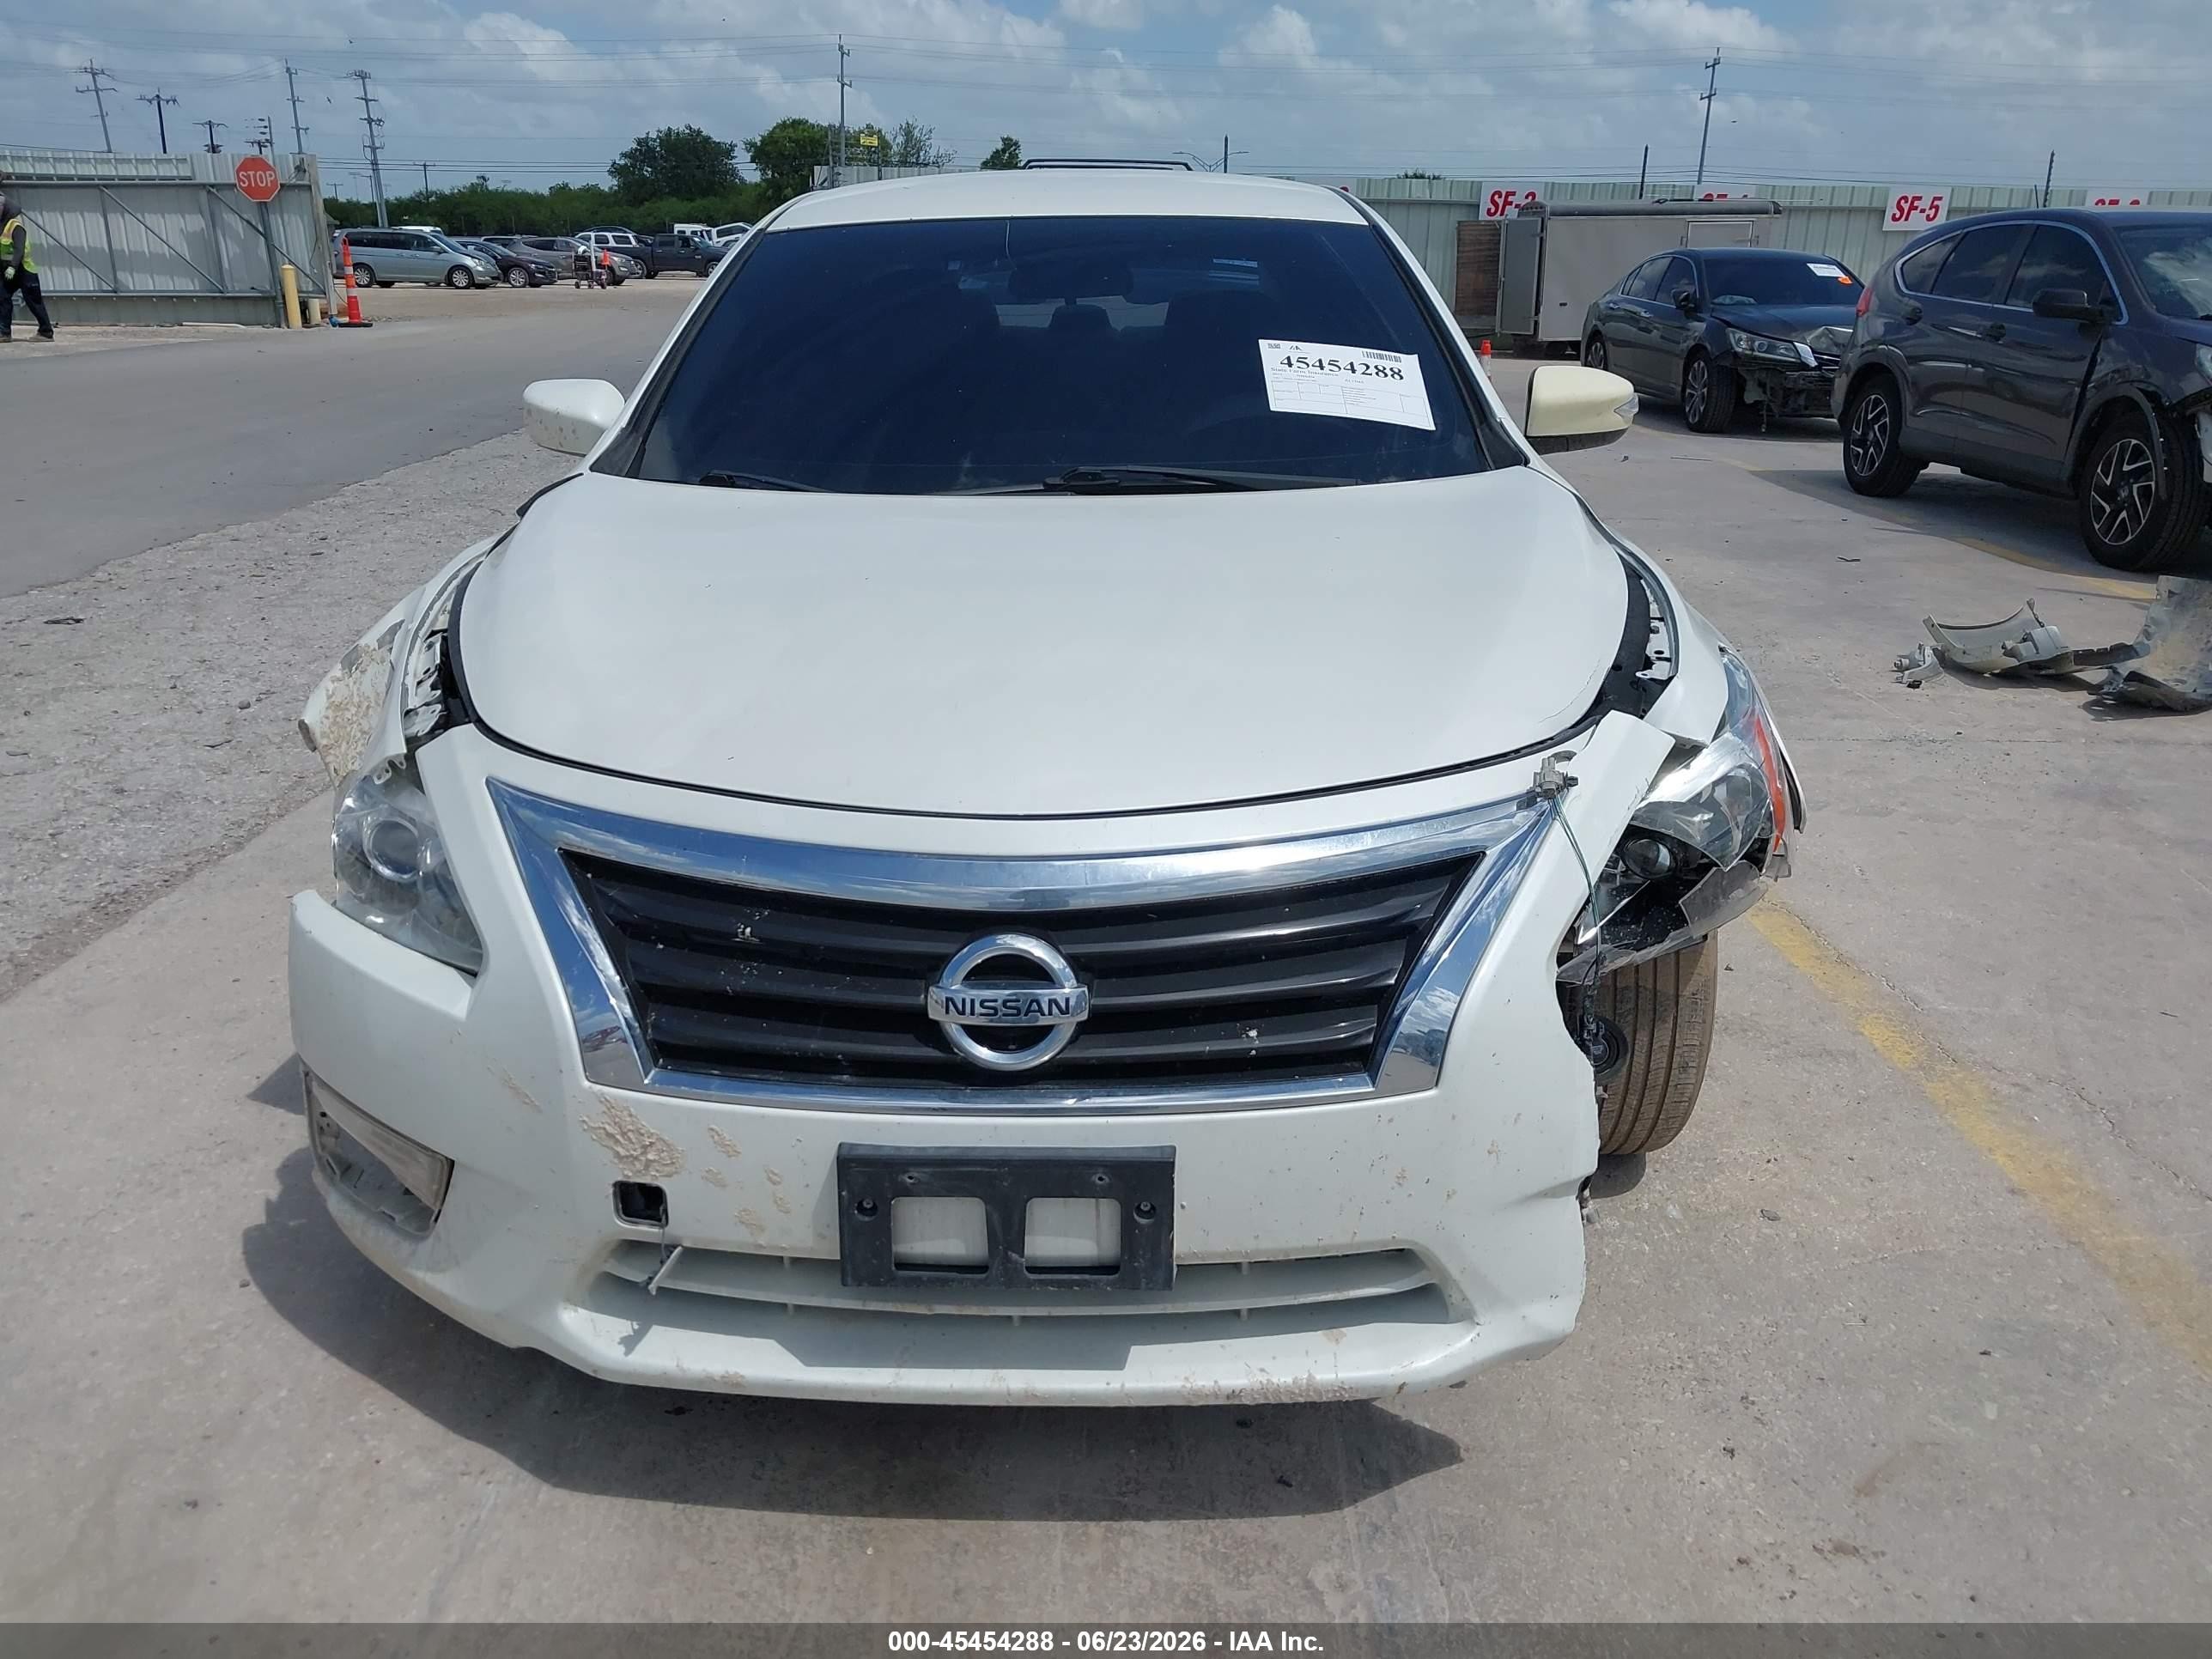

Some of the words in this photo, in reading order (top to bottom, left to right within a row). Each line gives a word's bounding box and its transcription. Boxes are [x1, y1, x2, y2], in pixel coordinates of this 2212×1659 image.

[240, 171, 275, 187] STOP
[1892, 195, 1943, 222] SF-5
[1279, 356, 1404, 380] 45454288
[945, 996, 1070, 1018] NISSAN
